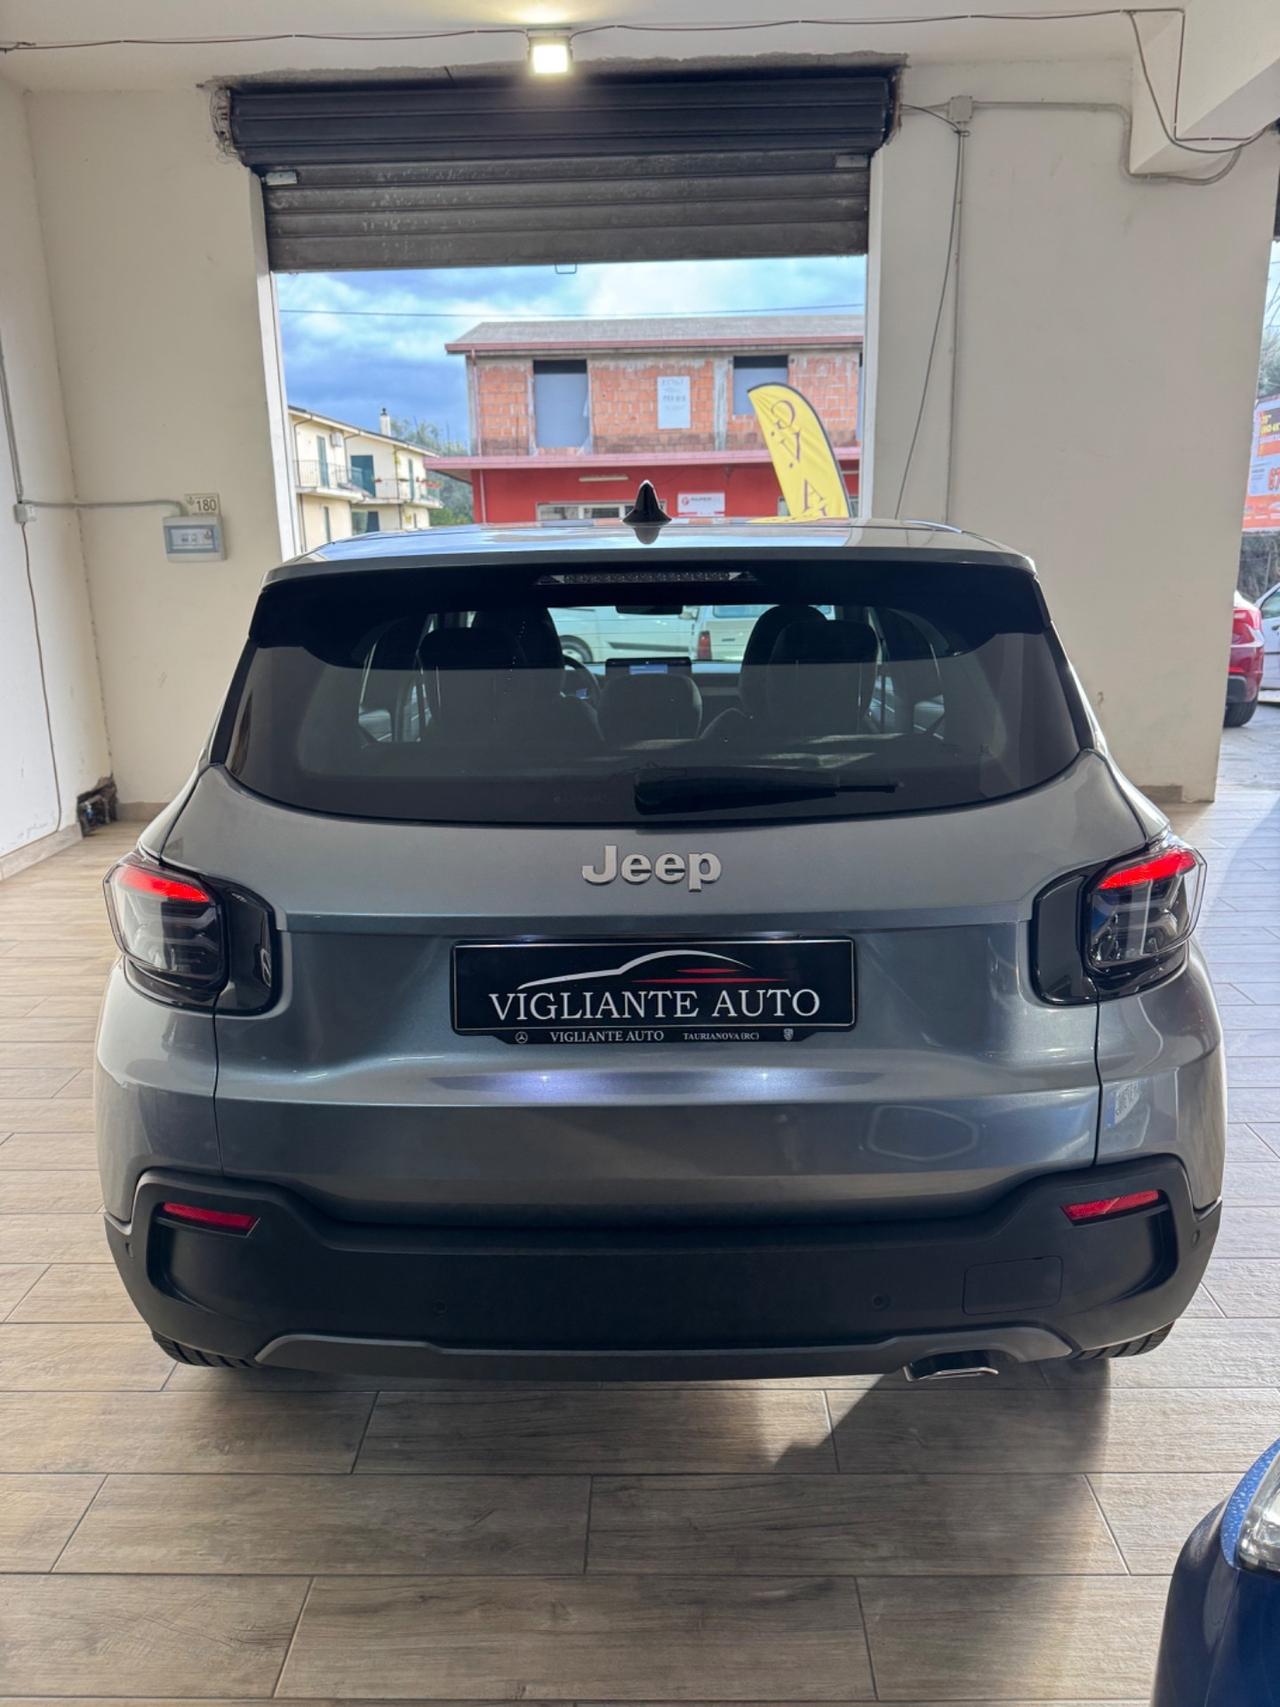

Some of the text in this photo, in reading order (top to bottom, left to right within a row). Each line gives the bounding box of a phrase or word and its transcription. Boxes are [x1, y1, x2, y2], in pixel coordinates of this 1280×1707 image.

[196, 499, 217, 511] 180
[582, 845, 721, 892] Jeep
[488, 988, 820, 1021] VIGLIANTE AUTO
[550, 1029, 760, 1042] VIGLIANTE AUTO TAURIANOVA (RC)
